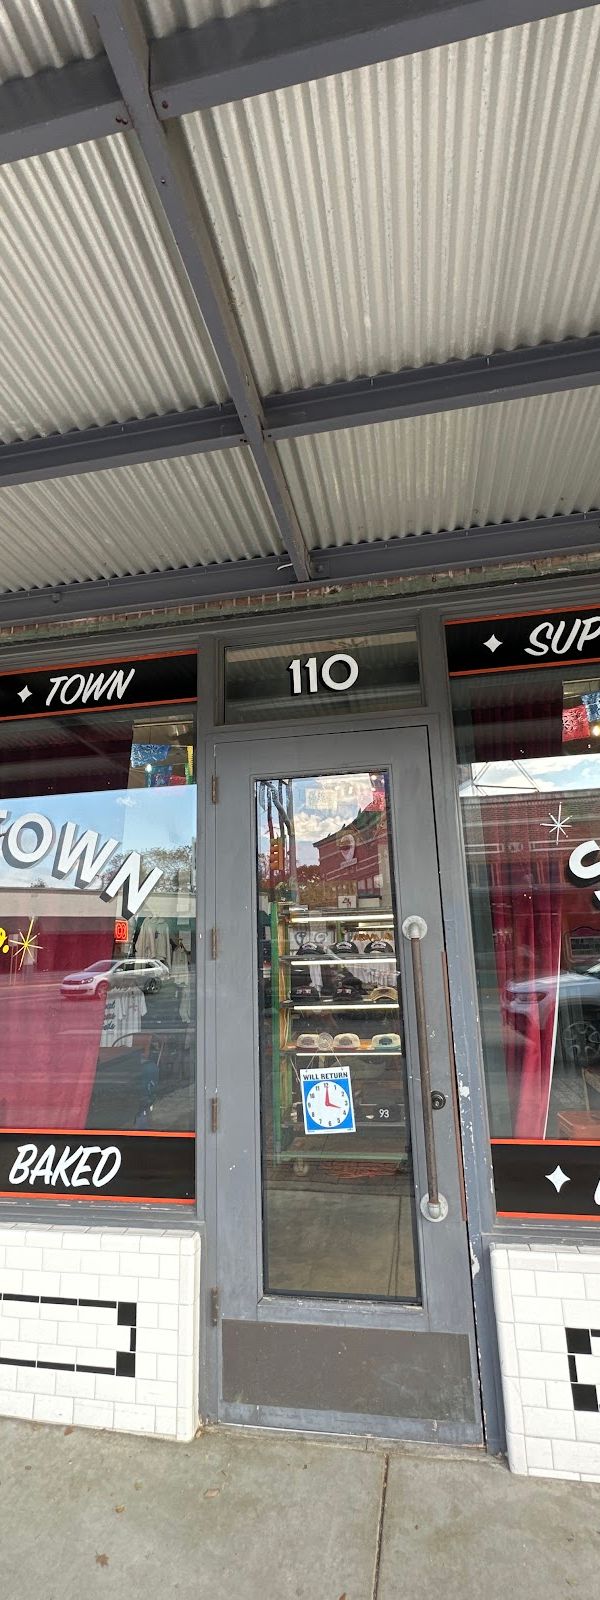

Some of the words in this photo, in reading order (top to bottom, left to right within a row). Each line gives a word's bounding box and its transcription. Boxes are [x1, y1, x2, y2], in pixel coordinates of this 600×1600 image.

[45, 668, 136, 706] TOWN
[288, 653, 359, 694] 110
[379, 1108, 390, 1118] 93
[8, 1143, 122, 1188] BAKED
